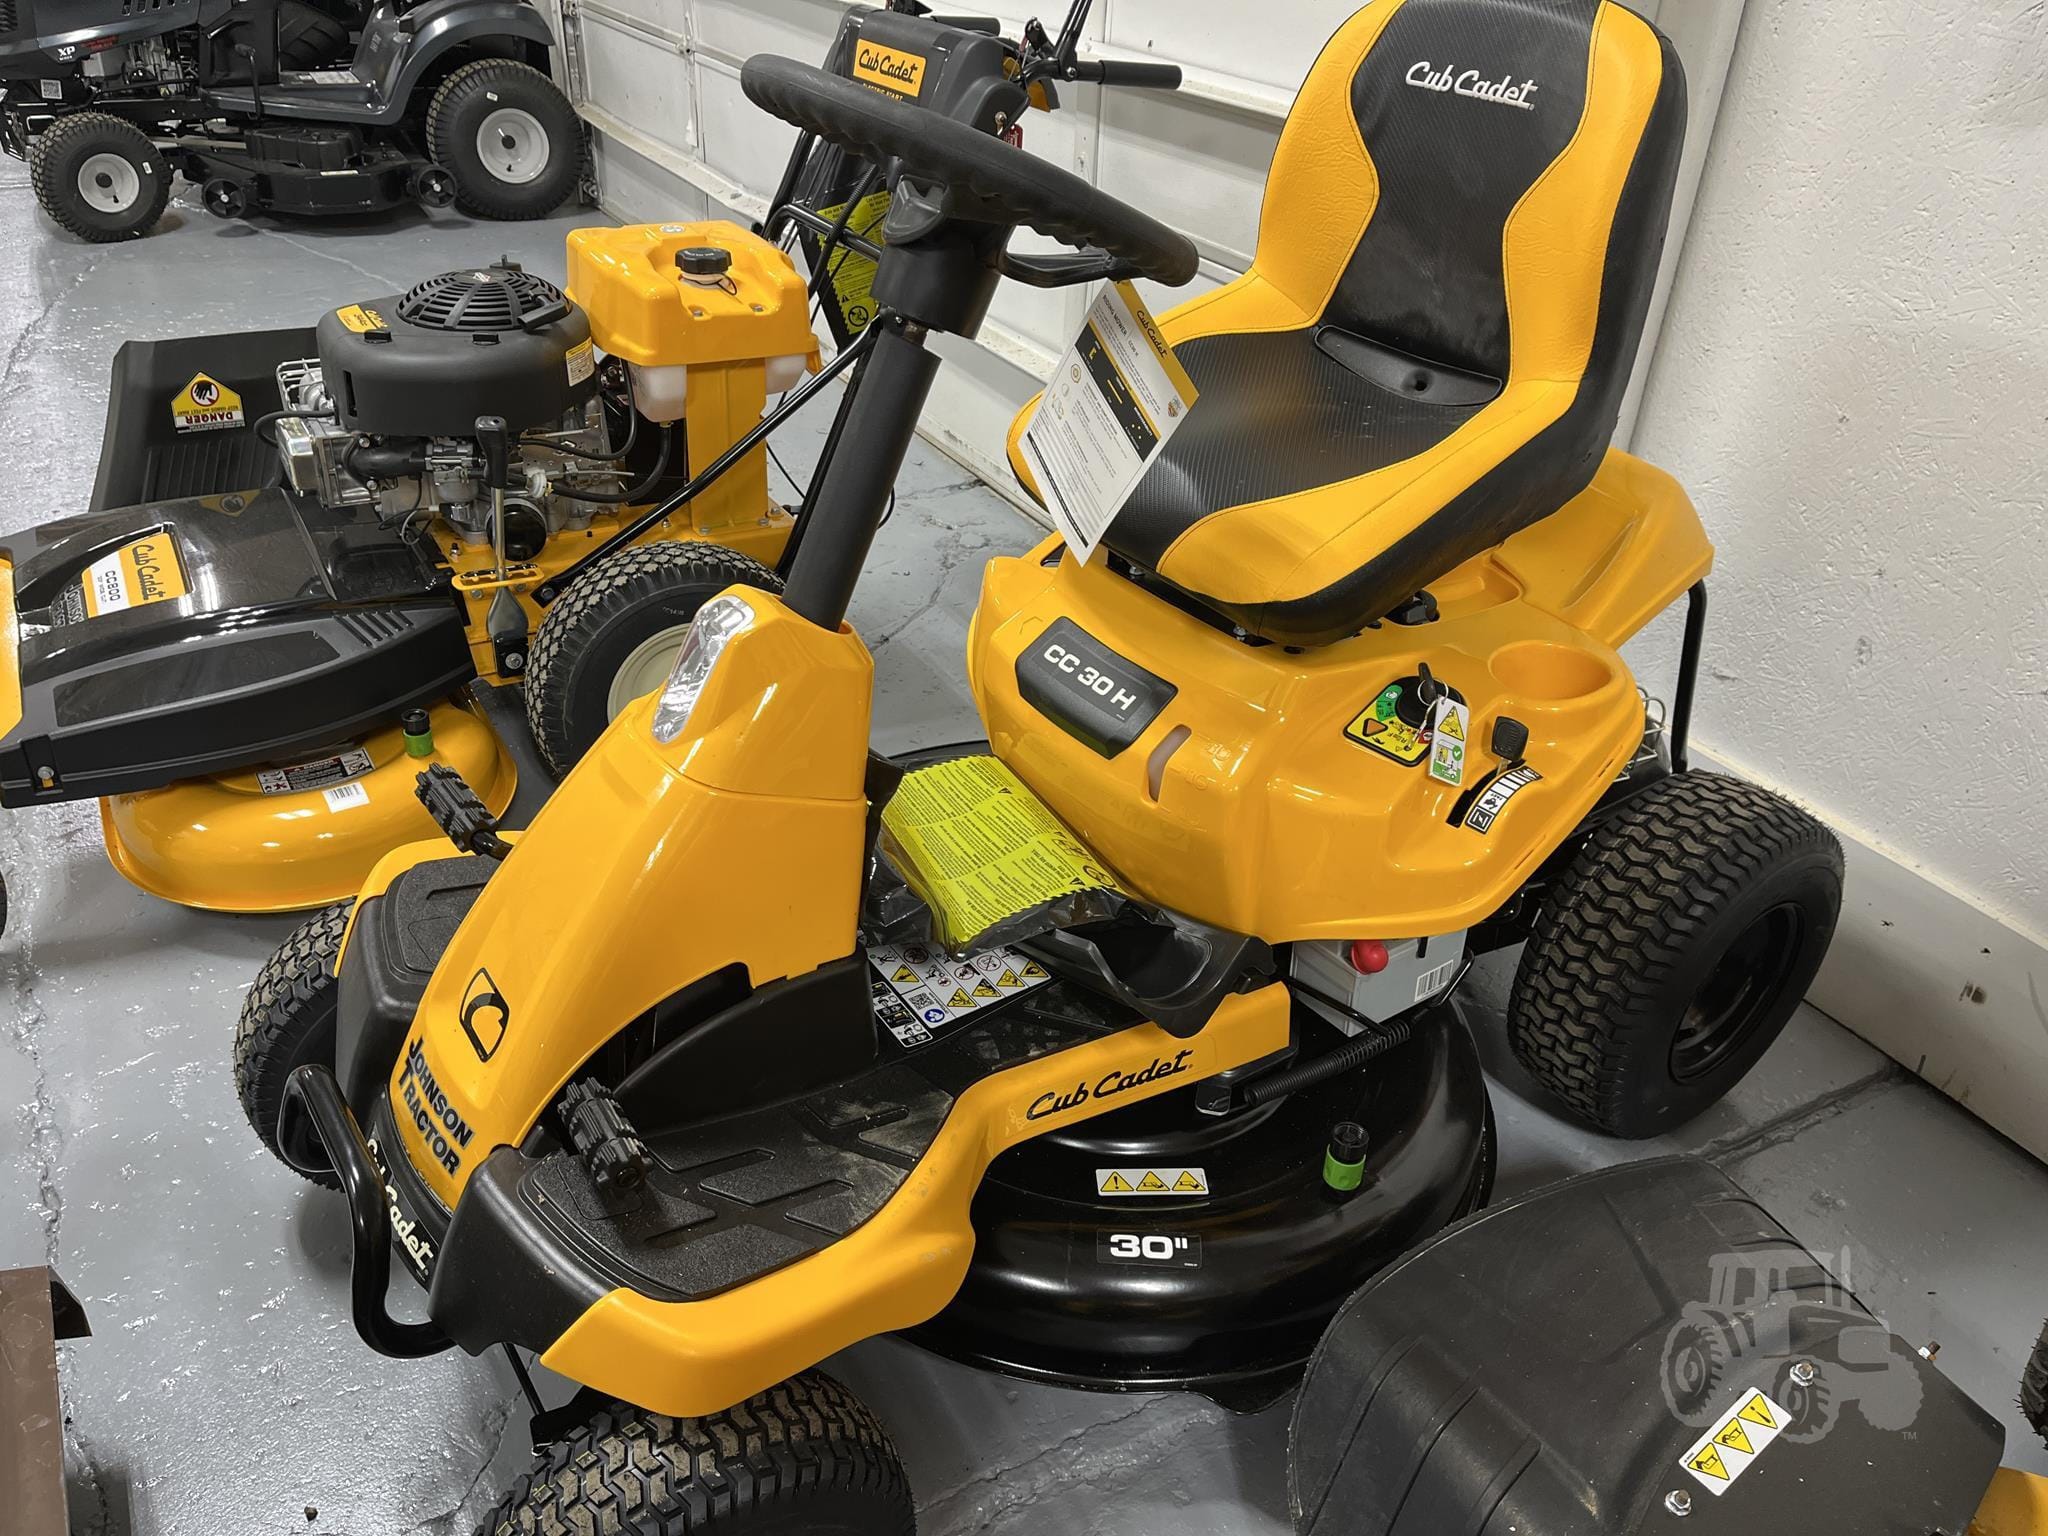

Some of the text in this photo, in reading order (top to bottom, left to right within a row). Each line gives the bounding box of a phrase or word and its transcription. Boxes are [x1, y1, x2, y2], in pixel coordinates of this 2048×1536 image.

[57, 46, 76, 56] XP
[858, 48, 918, 84] Cub Cadet
[1405, 61, 1539, 110] Cub Cadet
[1113, 314, 1128, 337] MOWER
[1136, 310, 1168, 359] Cub Cadet
[185, 411, 233, 424] DANGER
[132, 544, 166, 601] Cub Cadet
[1043, 644, 1136, 711] CC 30 H
[408, 1036, 475, 1149] JOHNSON
[1026, 1049, 1193, 1121] Cub Cadet
[398, 1057, 461, 1178] TRACTOR
[1110, 1234, 1188, 1260] 30"
